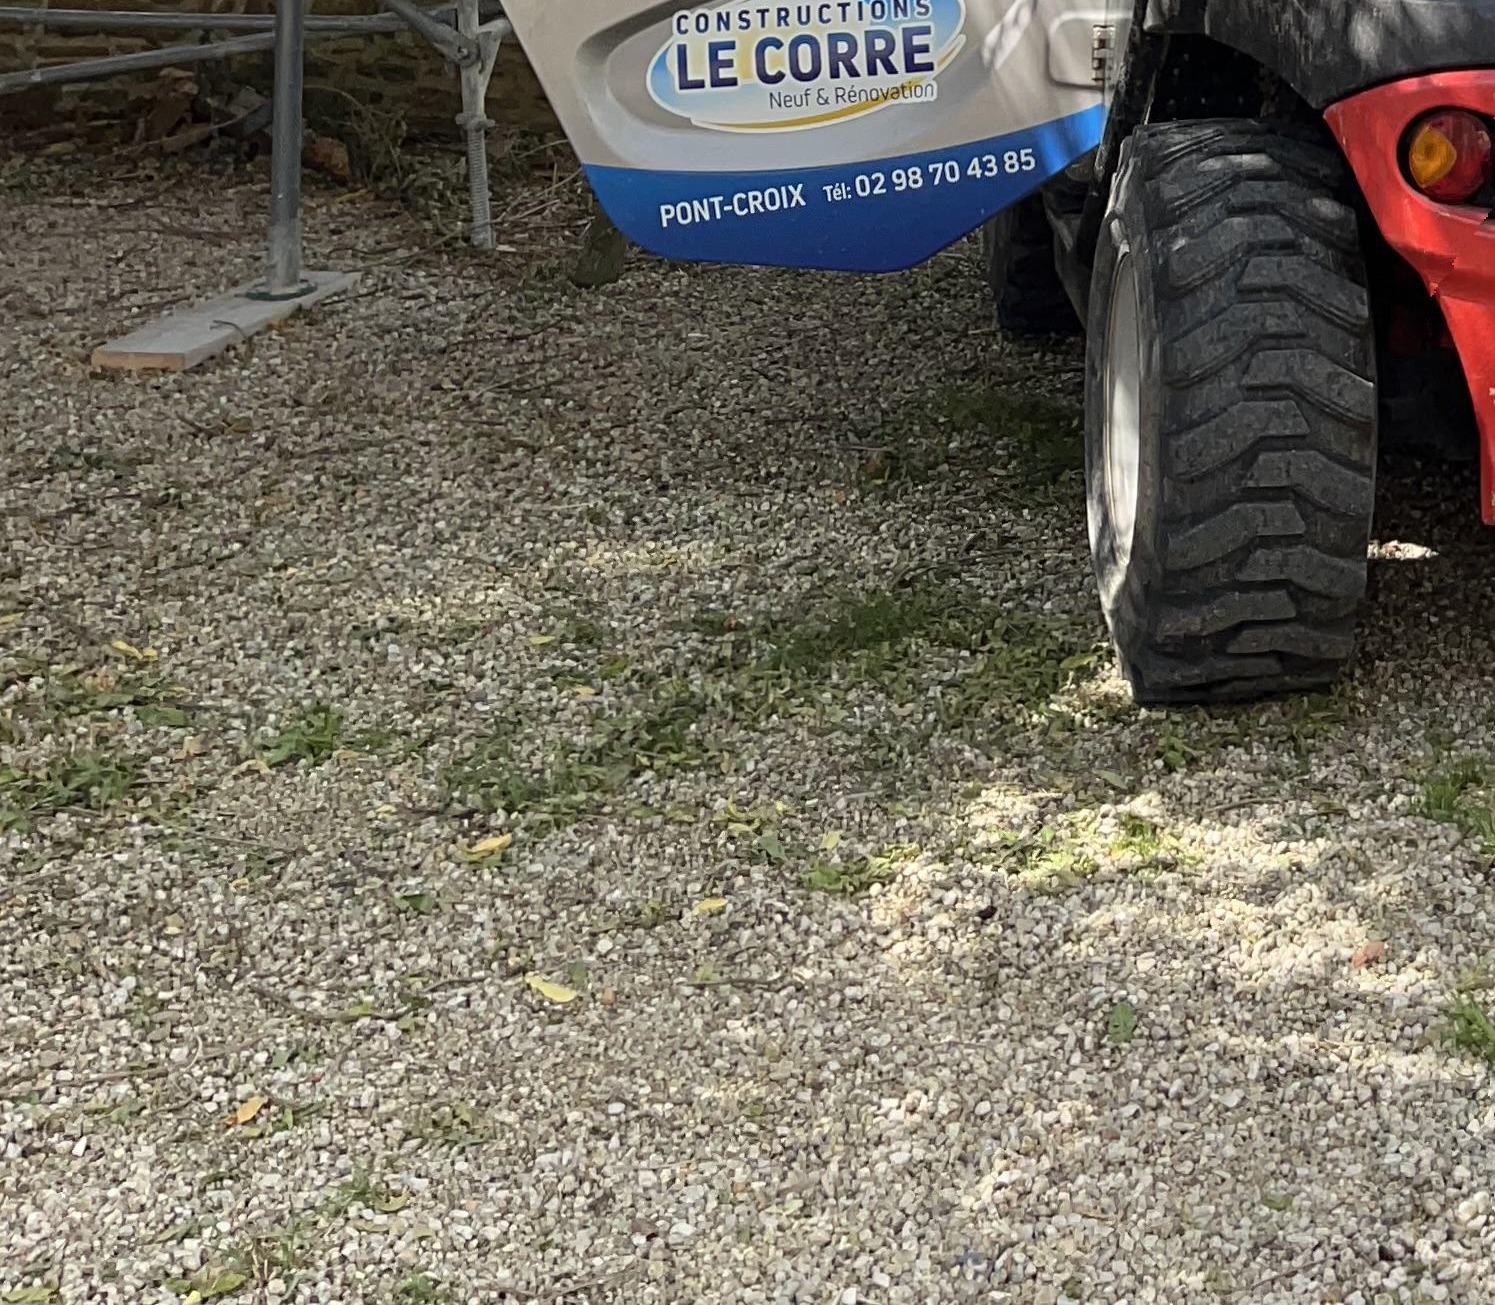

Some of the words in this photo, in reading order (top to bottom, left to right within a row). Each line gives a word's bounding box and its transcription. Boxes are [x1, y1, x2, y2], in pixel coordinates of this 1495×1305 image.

[677, 40, 739, 91] LE
[755, 25, 935, 85] CORRE
[769, 89, 811, 109] Neuf
[816, 88, 829, 106] &
[835, 82, 935, 104] Rénovation
[659, 183, 807, 228] PONT-CROIX
[823, 183, 853, 203] Tél:
[855, 173, 887, 198] 02
[893, 167, 924, 191] 98
[929, 160, 960, 186] 70
[966, 154, 998, 179] 43
[1004, 148, 1036, 173] 85
